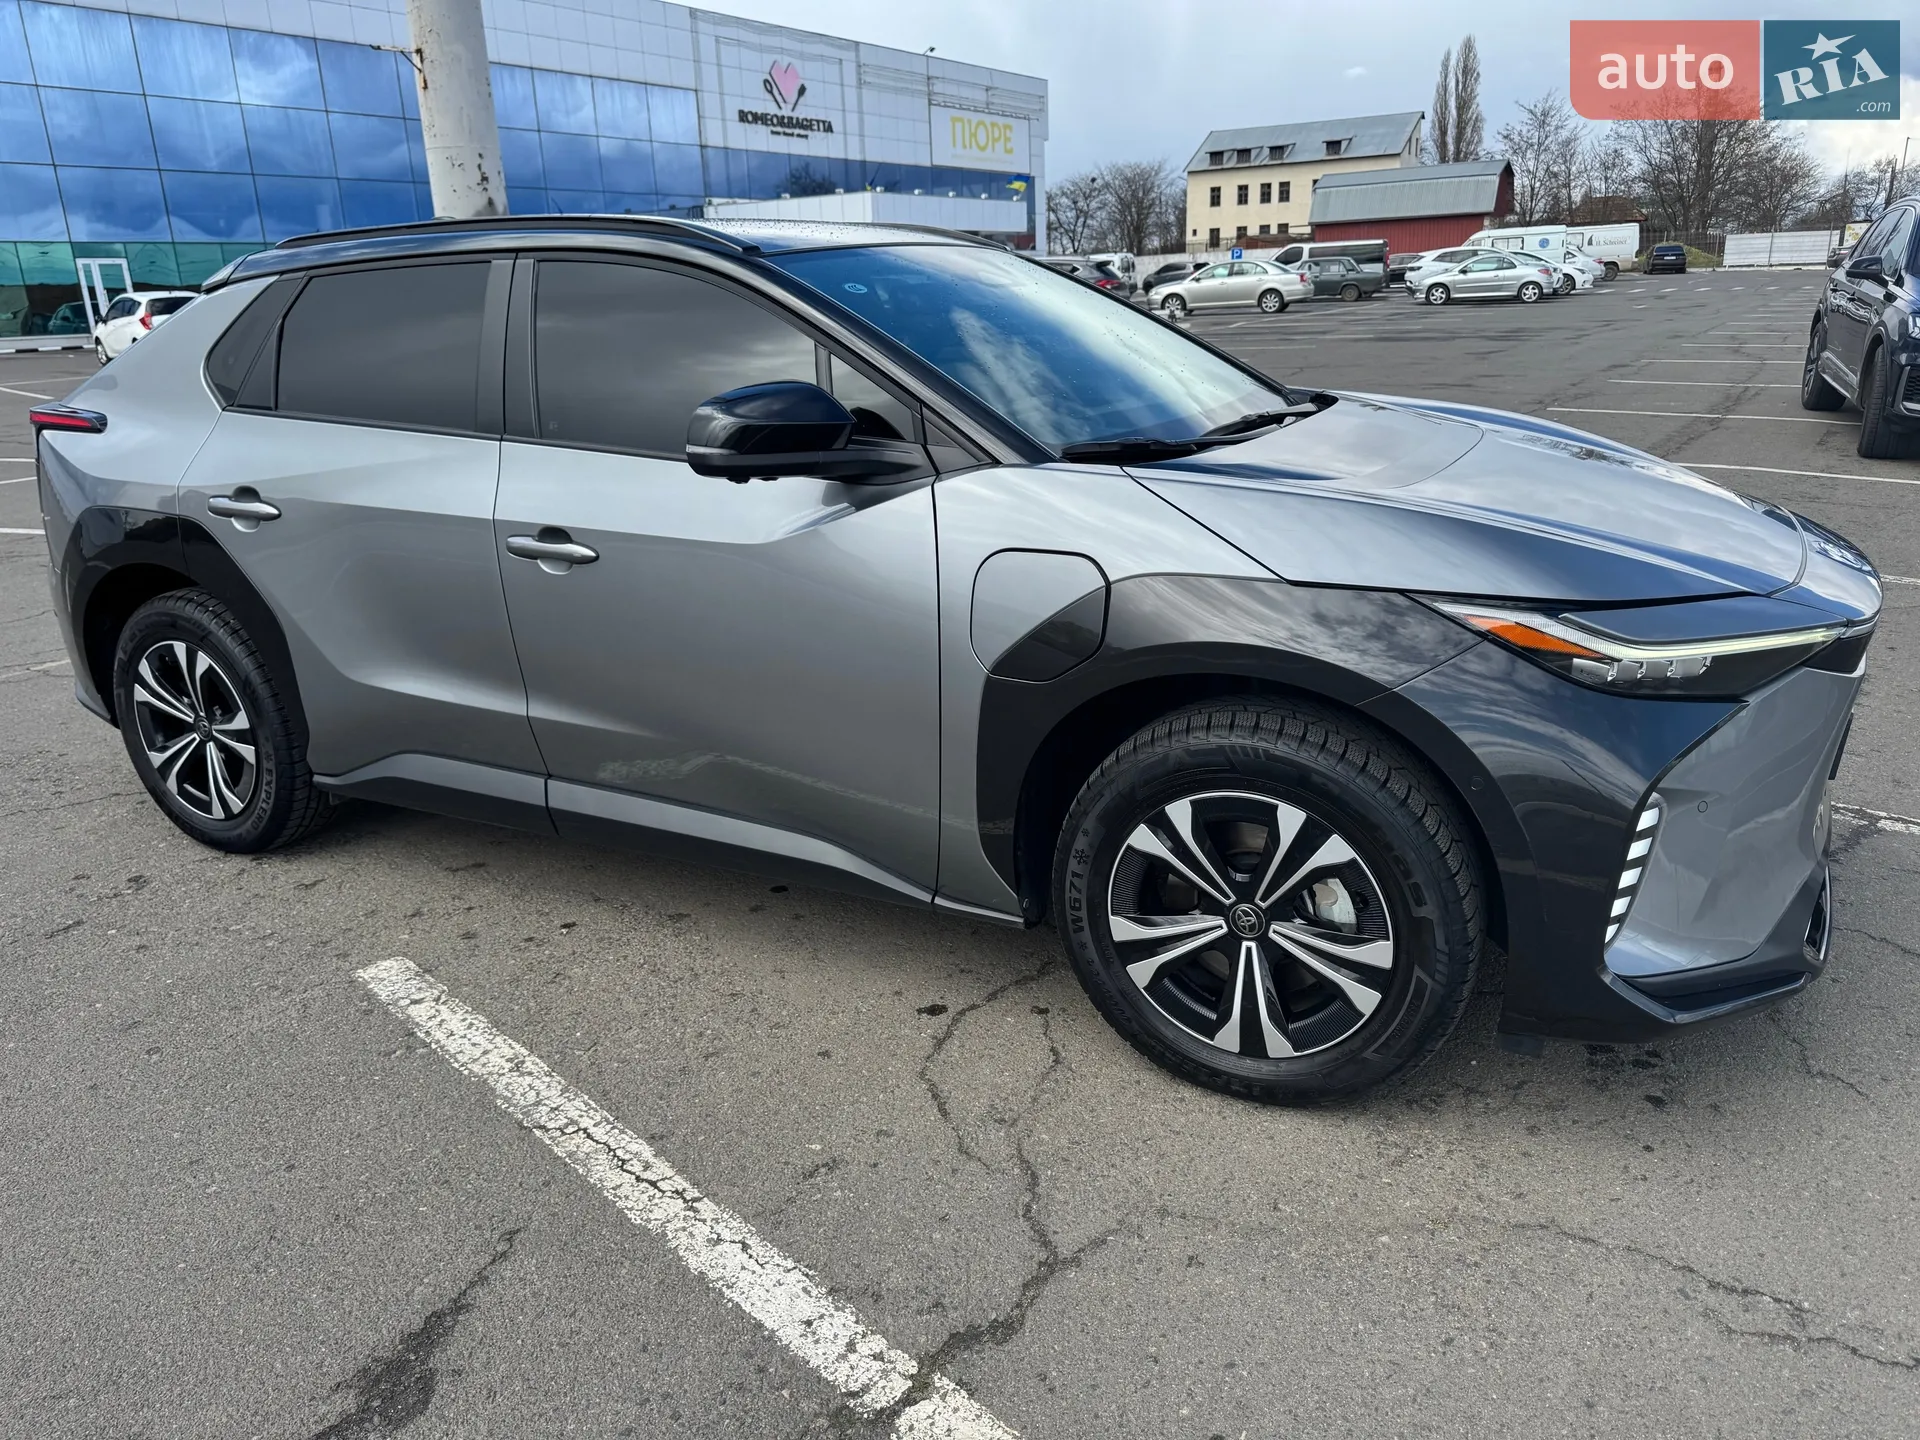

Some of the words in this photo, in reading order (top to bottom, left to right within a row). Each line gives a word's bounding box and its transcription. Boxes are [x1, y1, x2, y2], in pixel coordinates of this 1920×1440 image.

[950, 115, 1014, 155] ПЮРЕ
[250, 767, 274, 831] EXPLERO
[1068, 869, 1085, 935] W671
